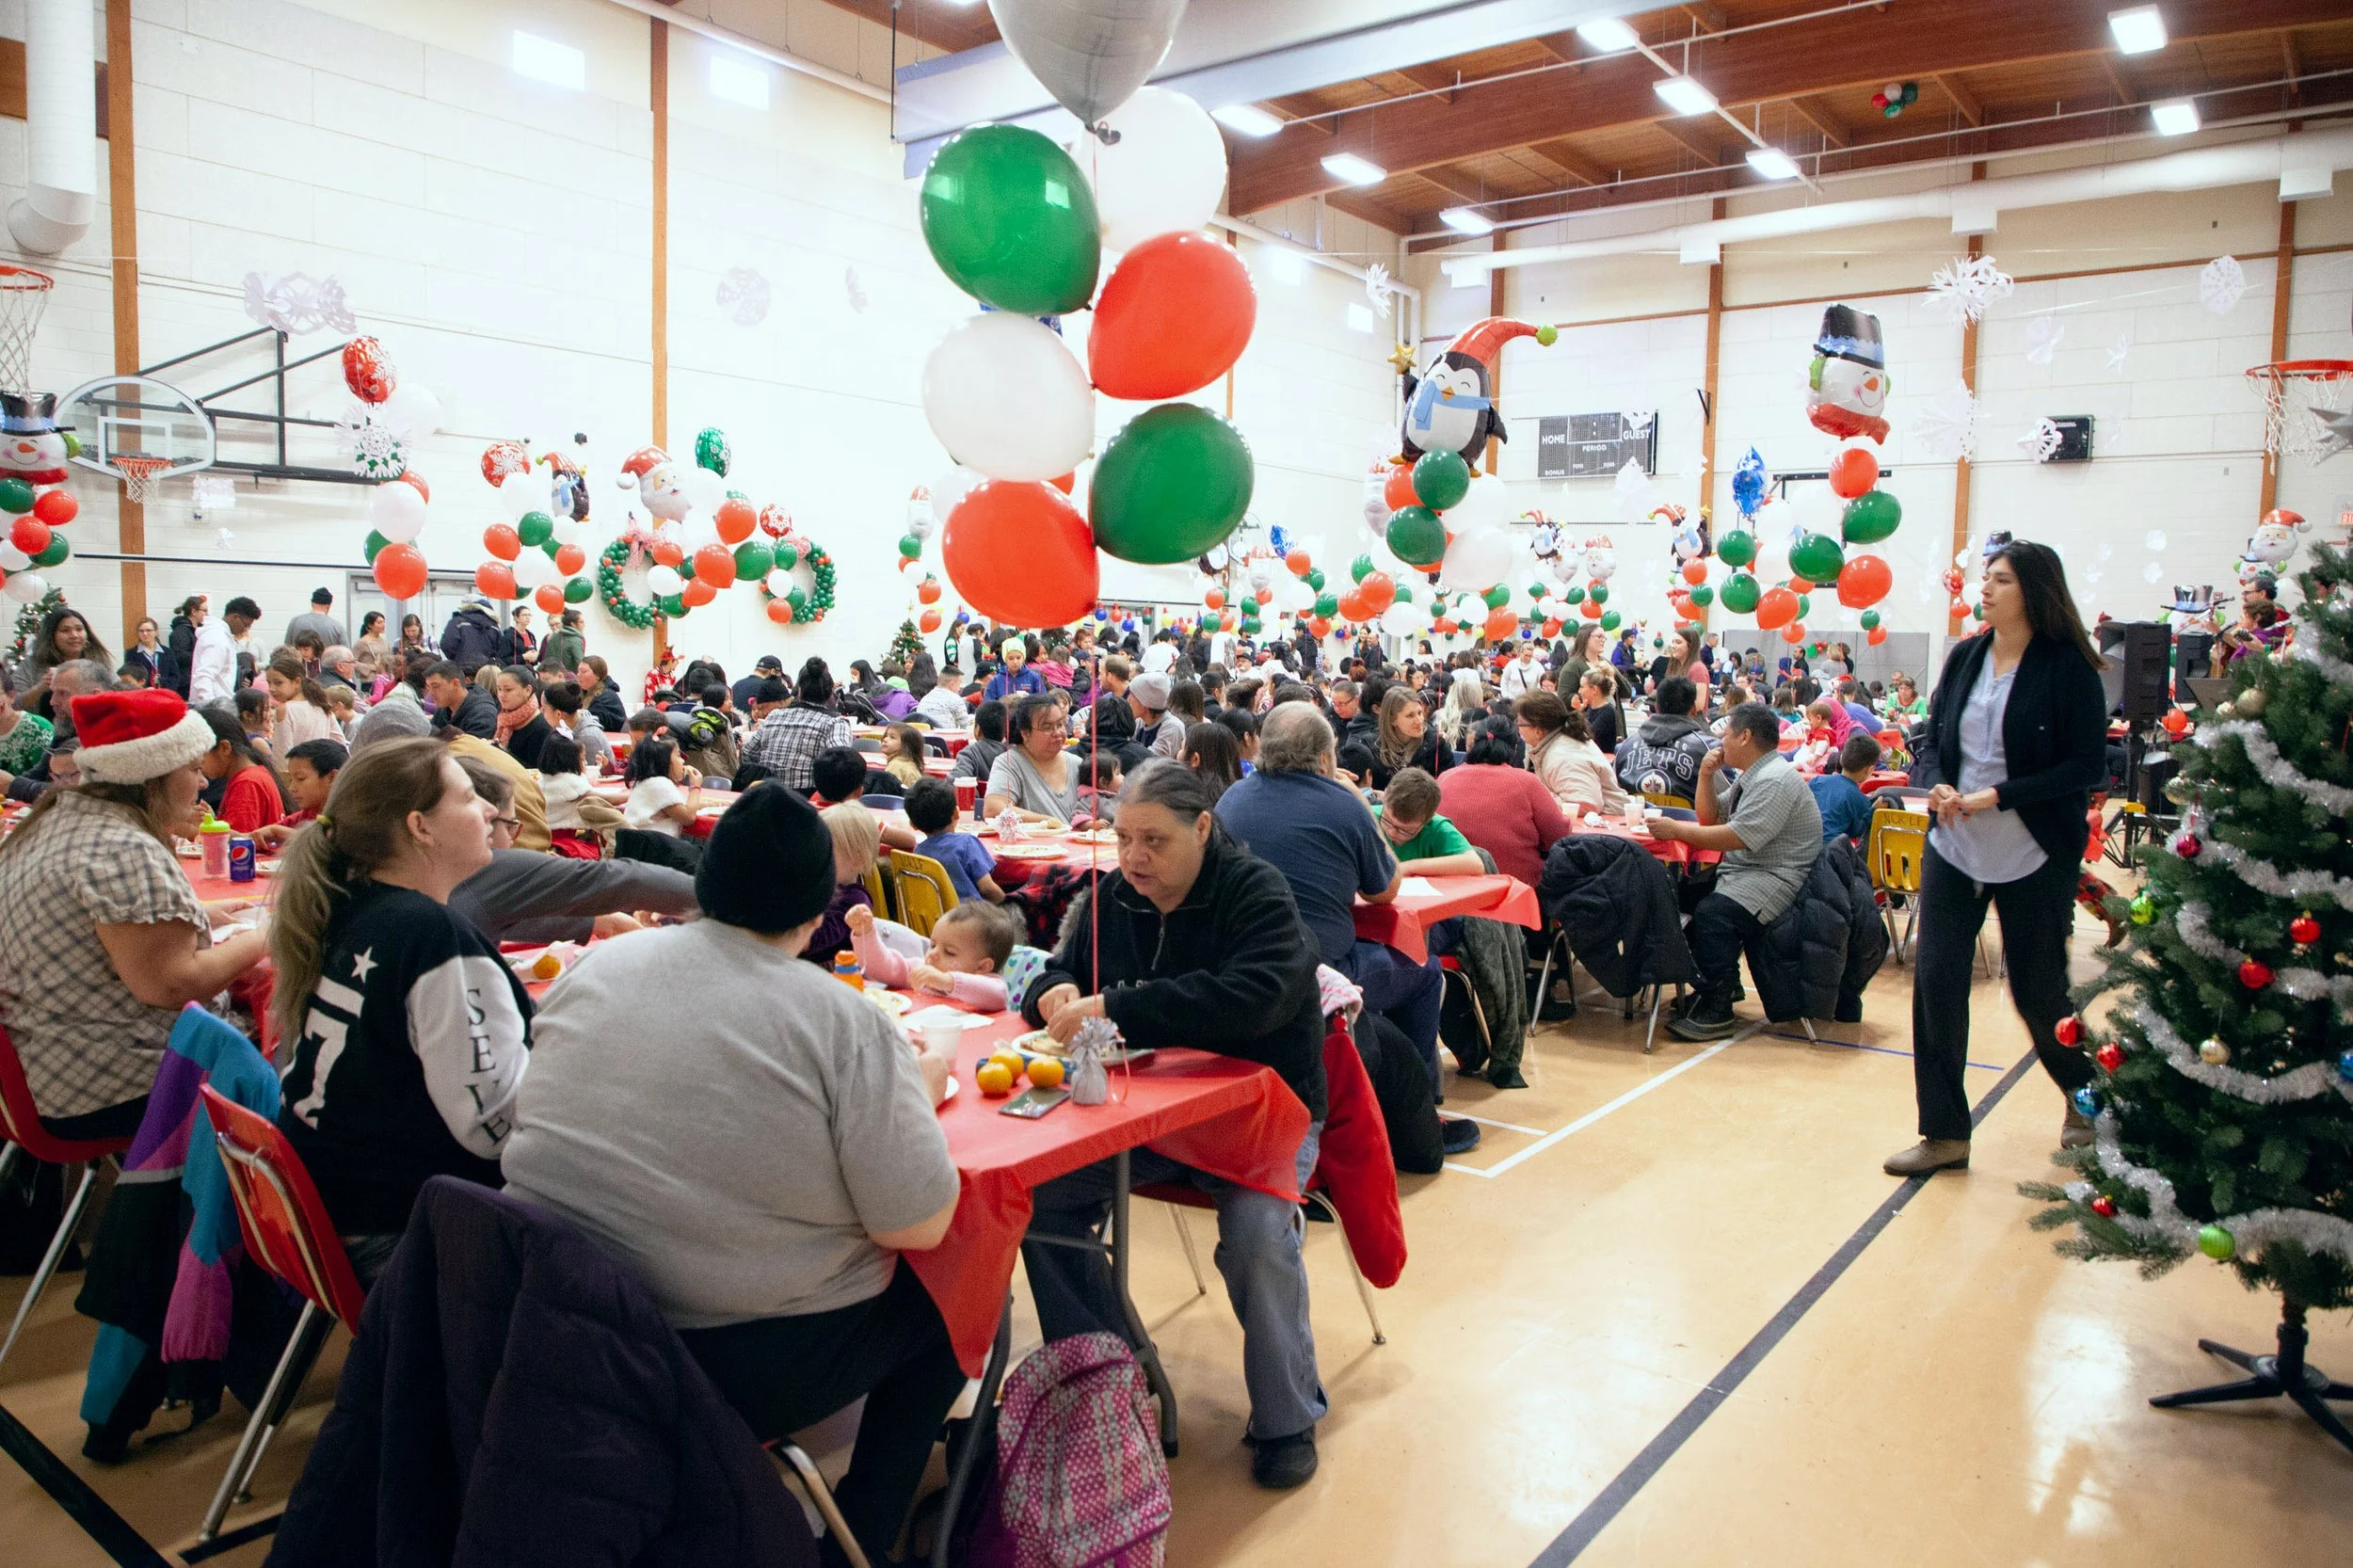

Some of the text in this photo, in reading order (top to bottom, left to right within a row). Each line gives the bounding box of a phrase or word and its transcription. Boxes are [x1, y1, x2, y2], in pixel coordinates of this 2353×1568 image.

[1542, 434, 1566, 445] HOME
[1623, 429, 1652, 440] GUEST
[1619, 746, 1694, 781] JETS
